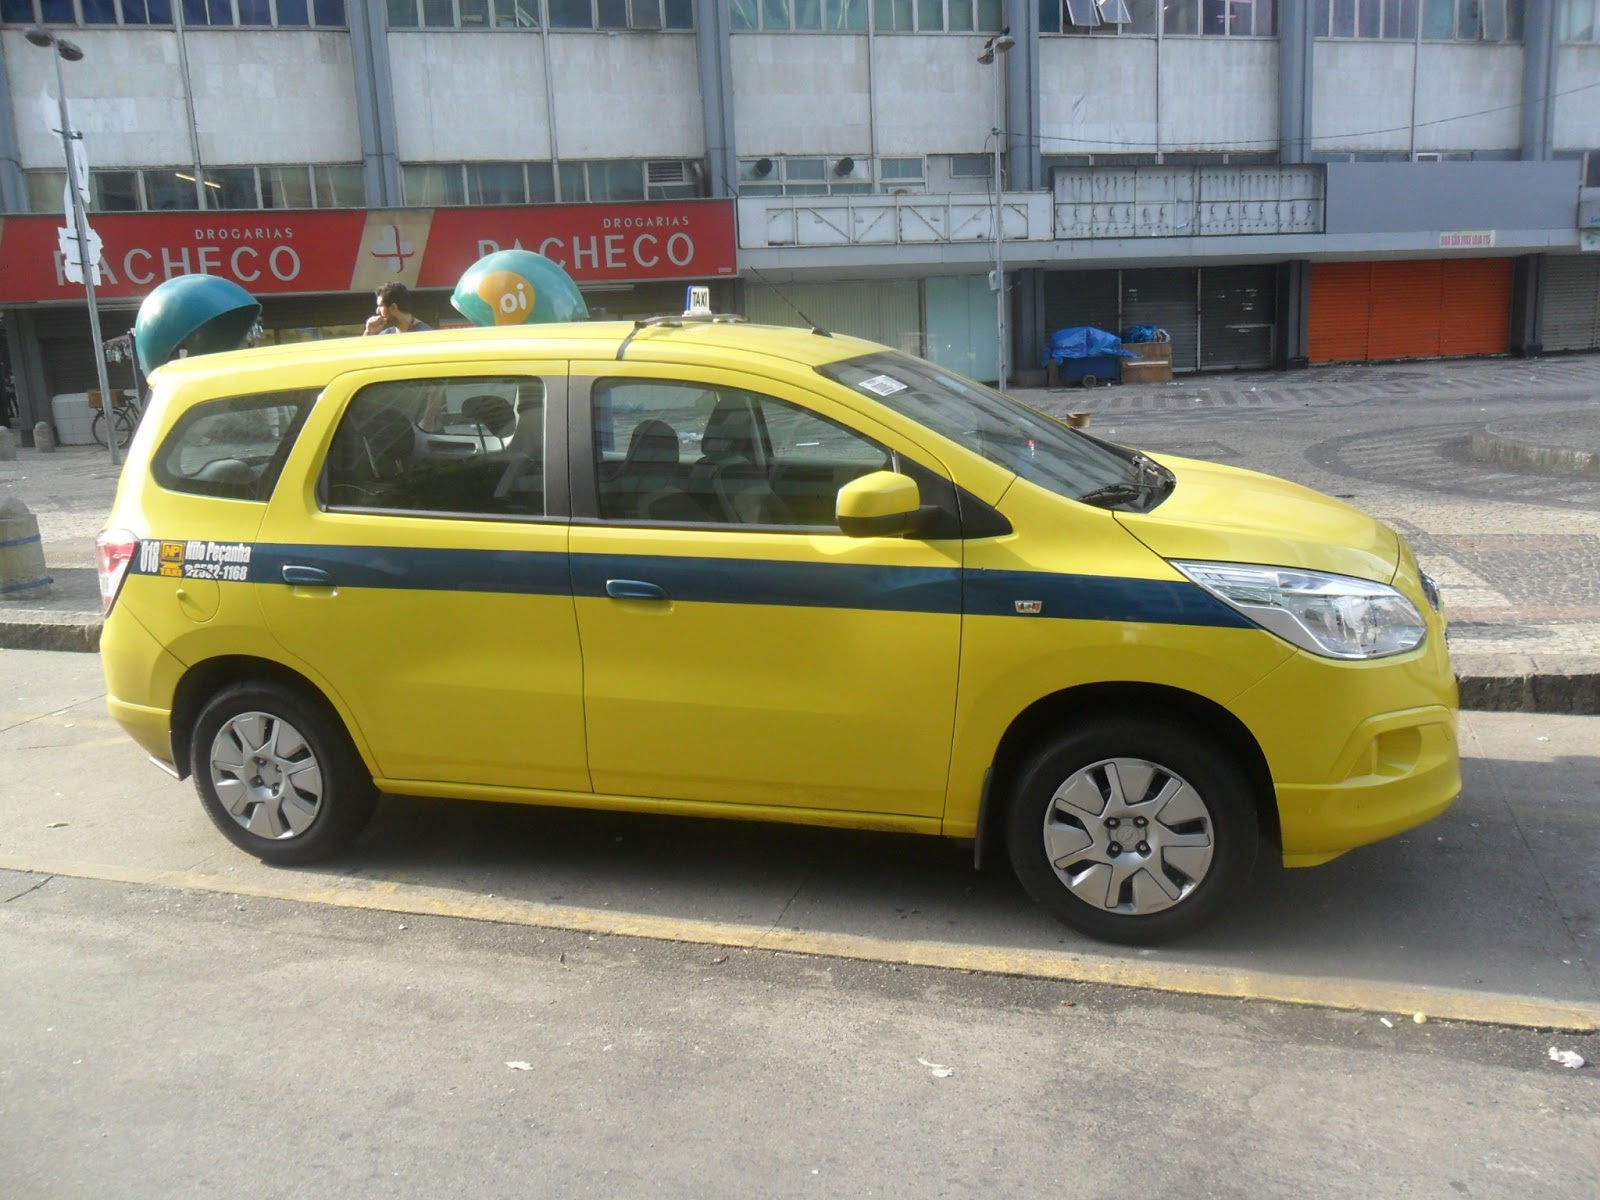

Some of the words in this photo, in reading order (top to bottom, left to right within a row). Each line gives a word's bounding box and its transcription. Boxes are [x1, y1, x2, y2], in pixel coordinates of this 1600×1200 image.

[602, 216, 690, 229] DROGARIAS
[194, 228, 294, 240] DROGARIAS
[500, 283, 527, 313] oi
[692, 291, 708, 307] TAXI
[140, 540, 160, 573] 018
[164, 545, 180, 557] NP
[206, 542, 251, 565] Peçanha
[160, 567, 183, 577] TAXI
